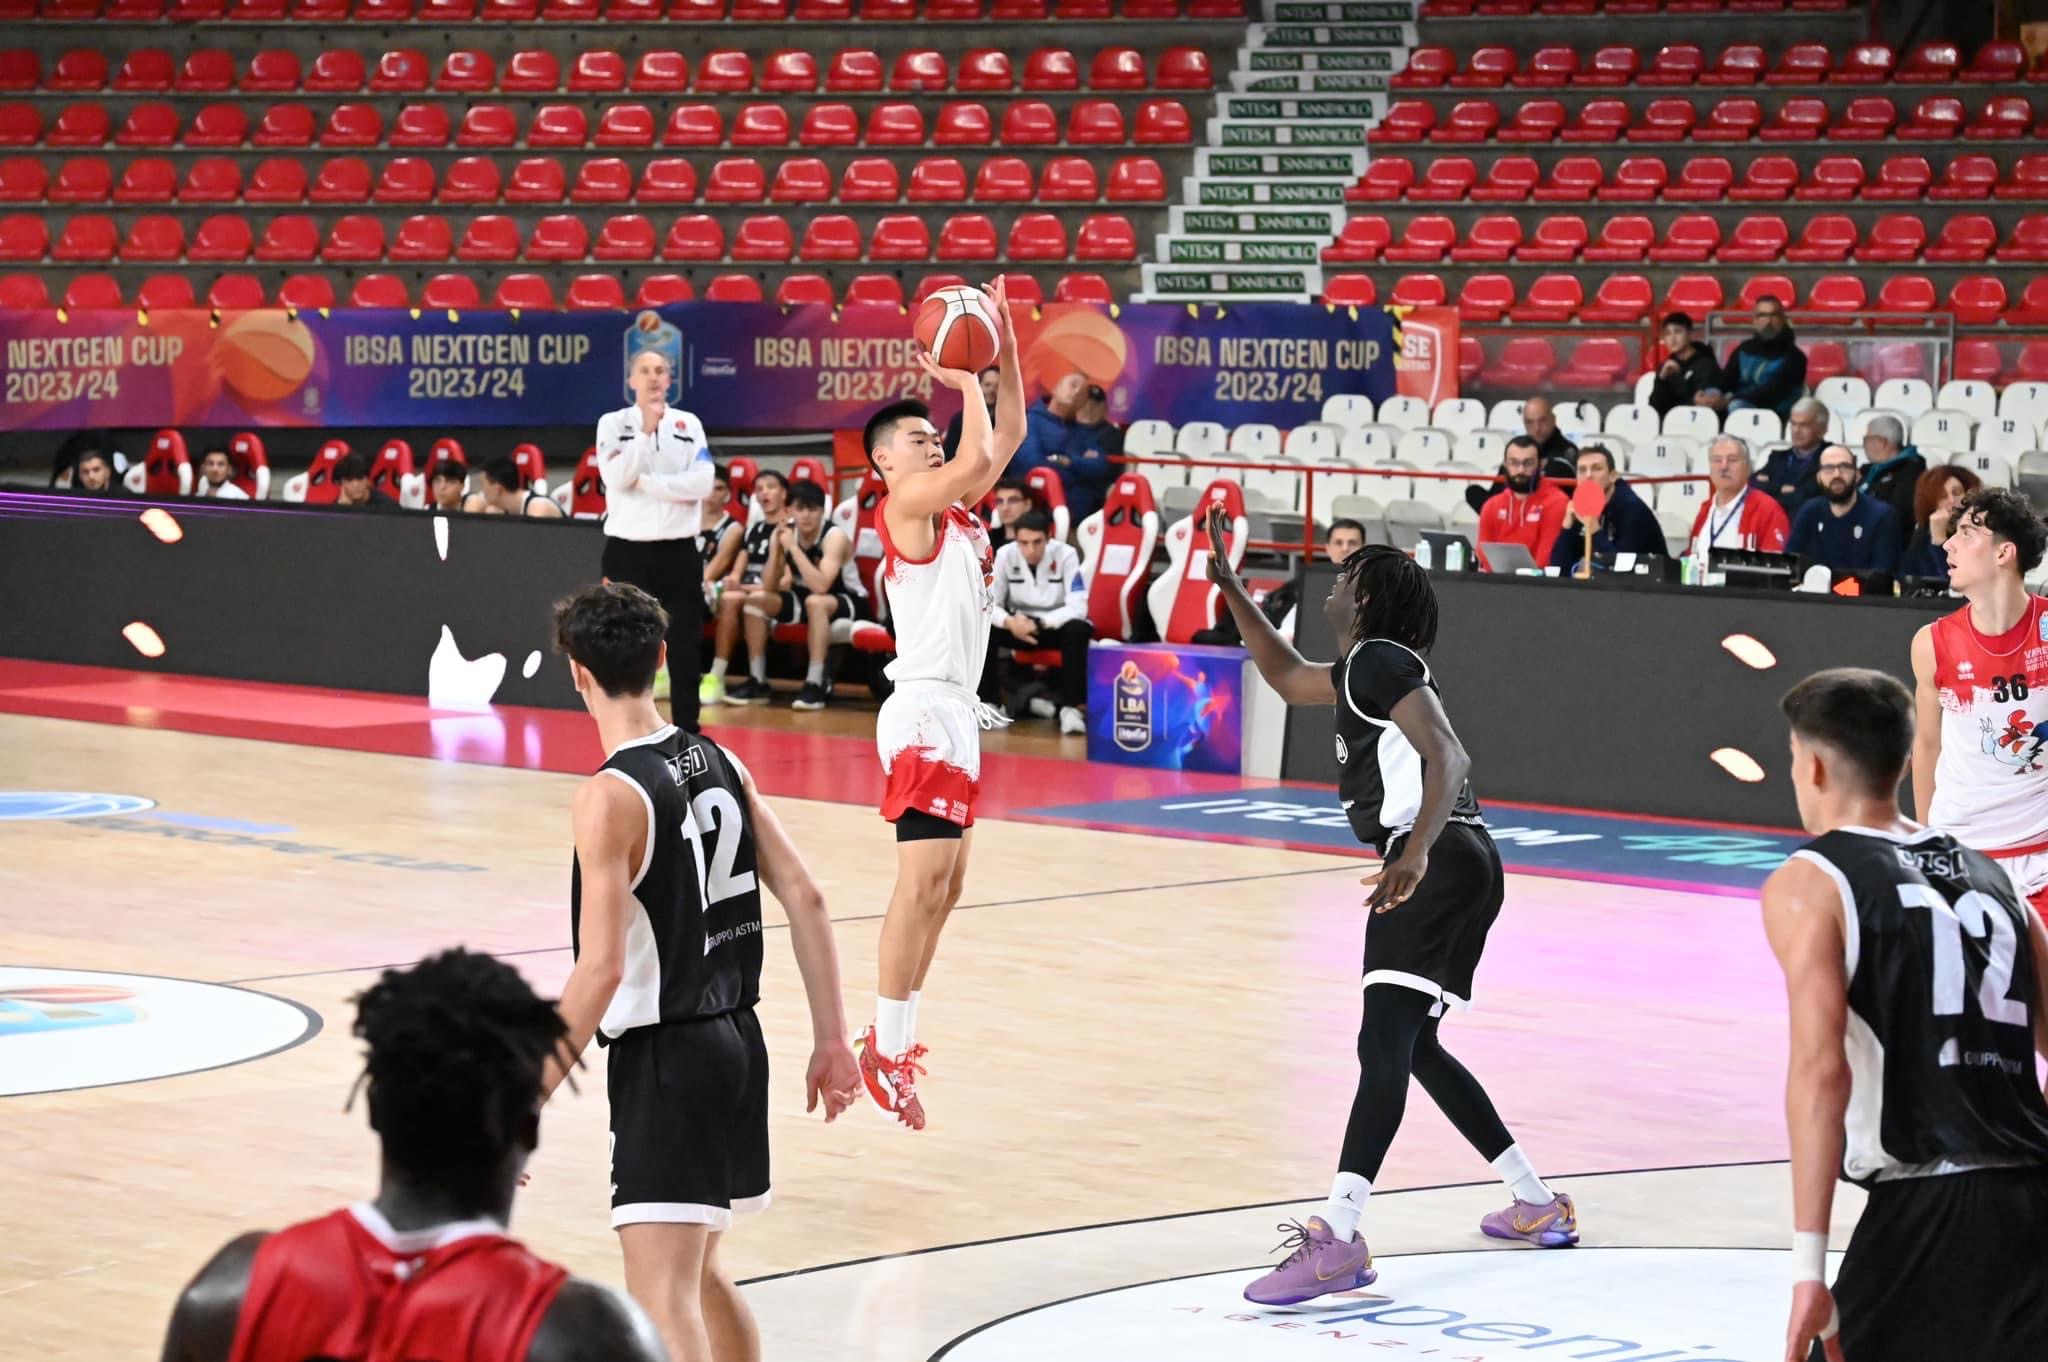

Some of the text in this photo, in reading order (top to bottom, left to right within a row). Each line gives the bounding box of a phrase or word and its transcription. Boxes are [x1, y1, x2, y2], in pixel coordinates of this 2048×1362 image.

[8, 335, 184, 369] NEXTGEN CUP
[345, 335, 590, 366] IBSA NEXTGEN CUP
[755, 338, 812, 368] IBSA
[821, 339, 920, 369] NEXTGE
[1154, 336, 1380, 370] IBSA NEXTGEN CUP
[6, 369, 119, 402] 2023/24
[409, 368, 526, 398] 2023/24
[817, 372, 933, 401] 2023/24
[1215, 371, 1323, 402] 2023/24
[1992, 673, 2029, 703] 36
[1119, 697, 1147, 713] LBA
[681, 787, 757, 913] 12
[735, 920, 761, 938] ASTM
